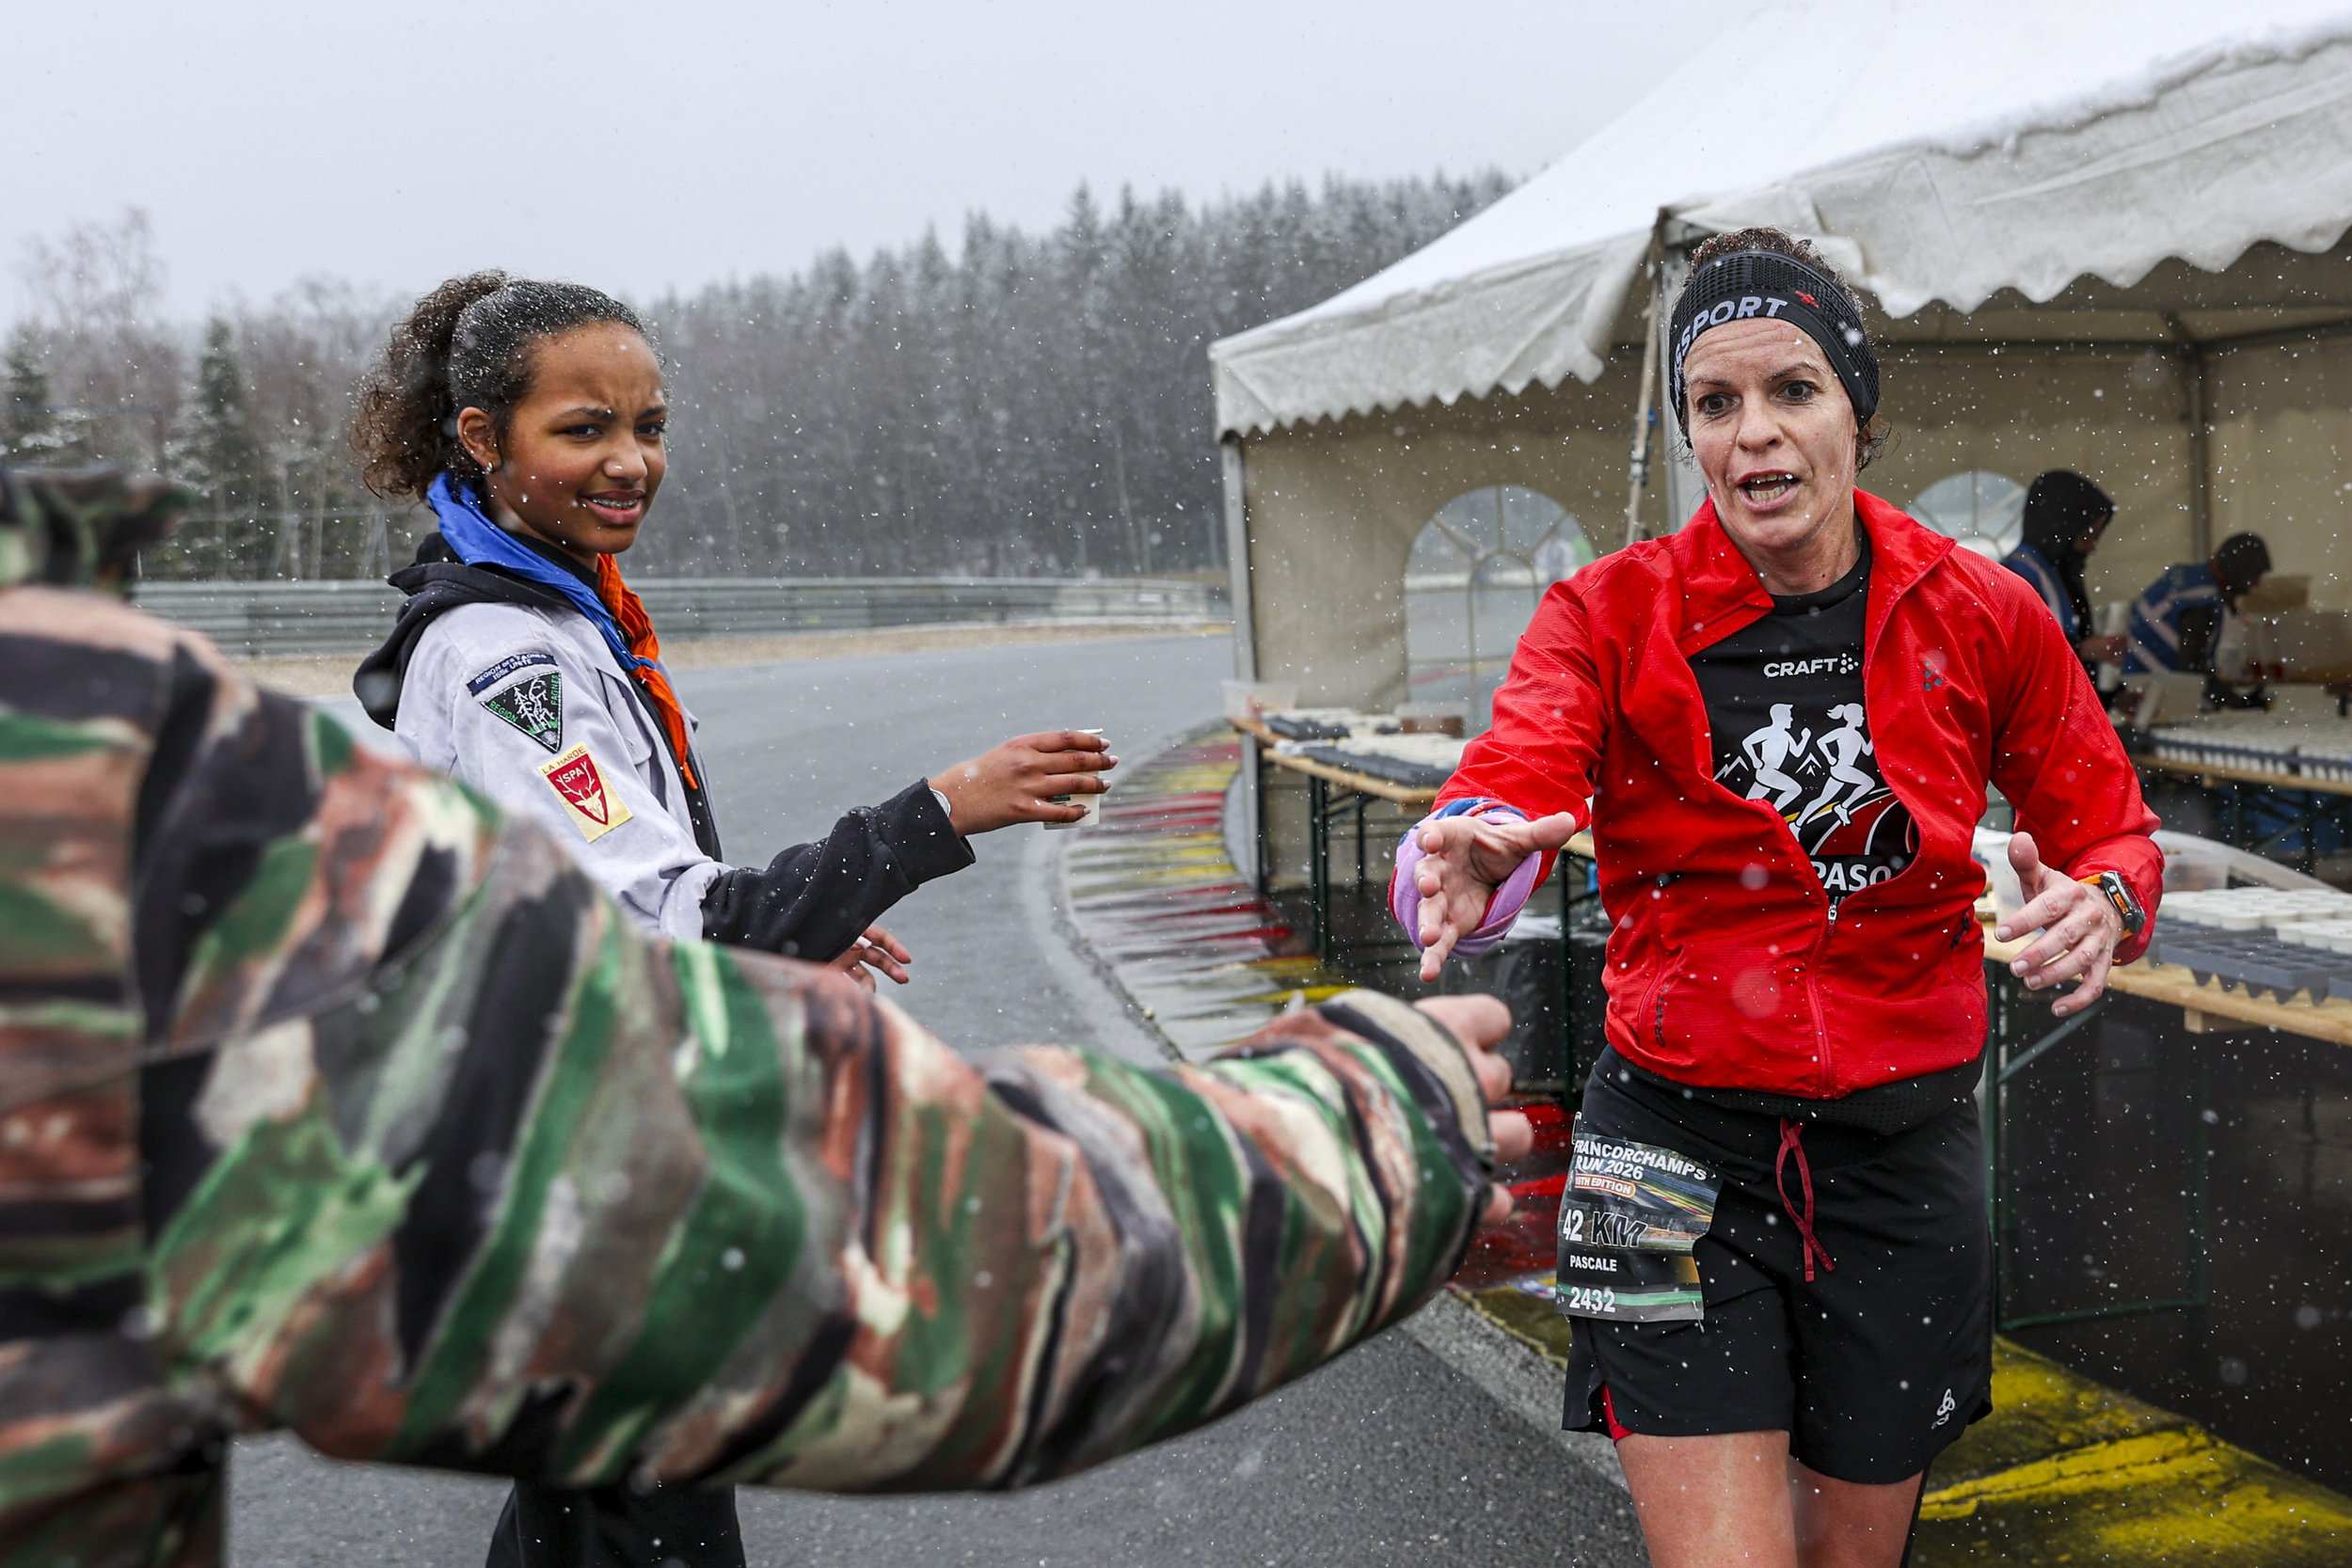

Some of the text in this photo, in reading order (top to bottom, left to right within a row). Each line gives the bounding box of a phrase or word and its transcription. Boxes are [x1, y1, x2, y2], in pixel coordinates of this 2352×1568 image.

[474, 664, 501, 685] REGION
[1763, 657, 1838, 678] CRAFT
[550, 674, 559, 705] FAGNES
[489, 700, 518, 722] REGION
[542, 746, 586, 774] LA HARDE
[562, 767, 584, 783] SPA
[1573, 1139, 1708, 1180] FRANCORCHAMPS
[1575, 1155, 1645, 1180] RUN 2026
[1591, 1177, 1632, 1195] EDITION
[1563, 1209, 1649, 1248] 42 KM
[1569, 1255, 1618, 1273] PASCALE
[1569, 1287, 1616, 1313] 2432
